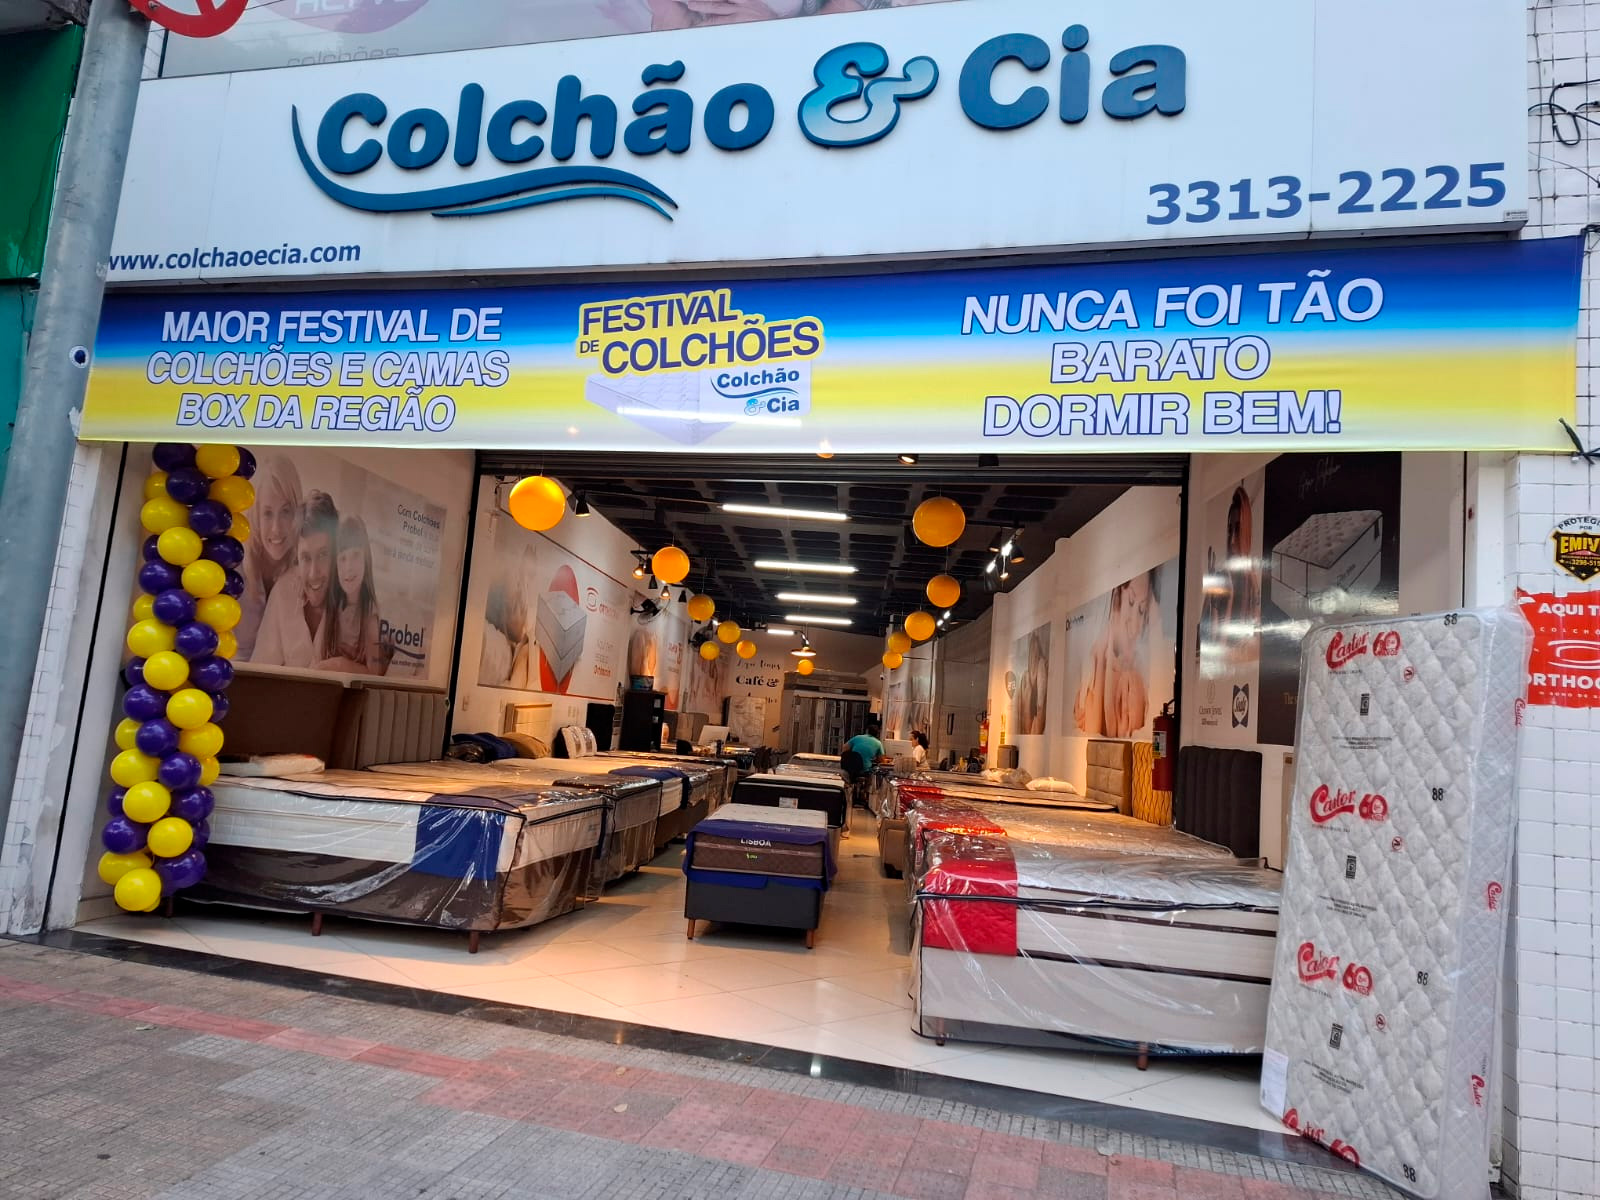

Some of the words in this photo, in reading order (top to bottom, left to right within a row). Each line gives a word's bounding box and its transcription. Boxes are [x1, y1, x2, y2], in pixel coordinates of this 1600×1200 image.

[317, 60, 775, 175] Colchão
[798, 41, 939, 148] &
[959, 24, 1187, 130] Cia
[1146, 162, 1506, 225] 3313-2225
[582, 292, 739, 336] FESTIVAL
[960, 288, 1140, 335] NUNCA
[1153, 283, 1243, 328] FOI
[1257, 268, 1386, 324] TÃO
[161, 310, 270, 343] MAIOR
[277, 308, 440, 344] FESTIVAL
[448, 306, 504, 343] DE
[147, 343, 332, 387] COLCHÕES
[339, 351, 365, 387] E
[373, 350, 510, 388] CAMAS
[579, 340, 600, 354] DE
[602, 318, 821, 375] COLCHÕES
[1049, 335, 1272, 384] BARATO
[716, 367, 800, 389] Colchão
[176, 393, 250, 428] BOX
[254, 394, 303, 429] DA
[311, 385, 456, 432] REGIÃO
[766, 396, 801, 414] Cia
[983, 392, 1190, 438] DORMIR
[1202, 389, 1342, 436] BEM!
[1443, 613, 1458, 626] 88
[1538, 602, 1584, 617] AQUI
[379, 619, 425, 648] Probel
[1326, 631, 1370, 669] Castor
[735, 675, 765, 686] Café
[1310, 784, 1356, 823] Castor
[1358, 794, 1388, 820] 60
[1431, 787, 1445, 802] 88
[740, 838, 772, 848] LISBOA
[1342, 962, 1373, 994] 60
[1416, 971, 1429, 986] 88
[1402, 1163, 1417, 1183] 88
